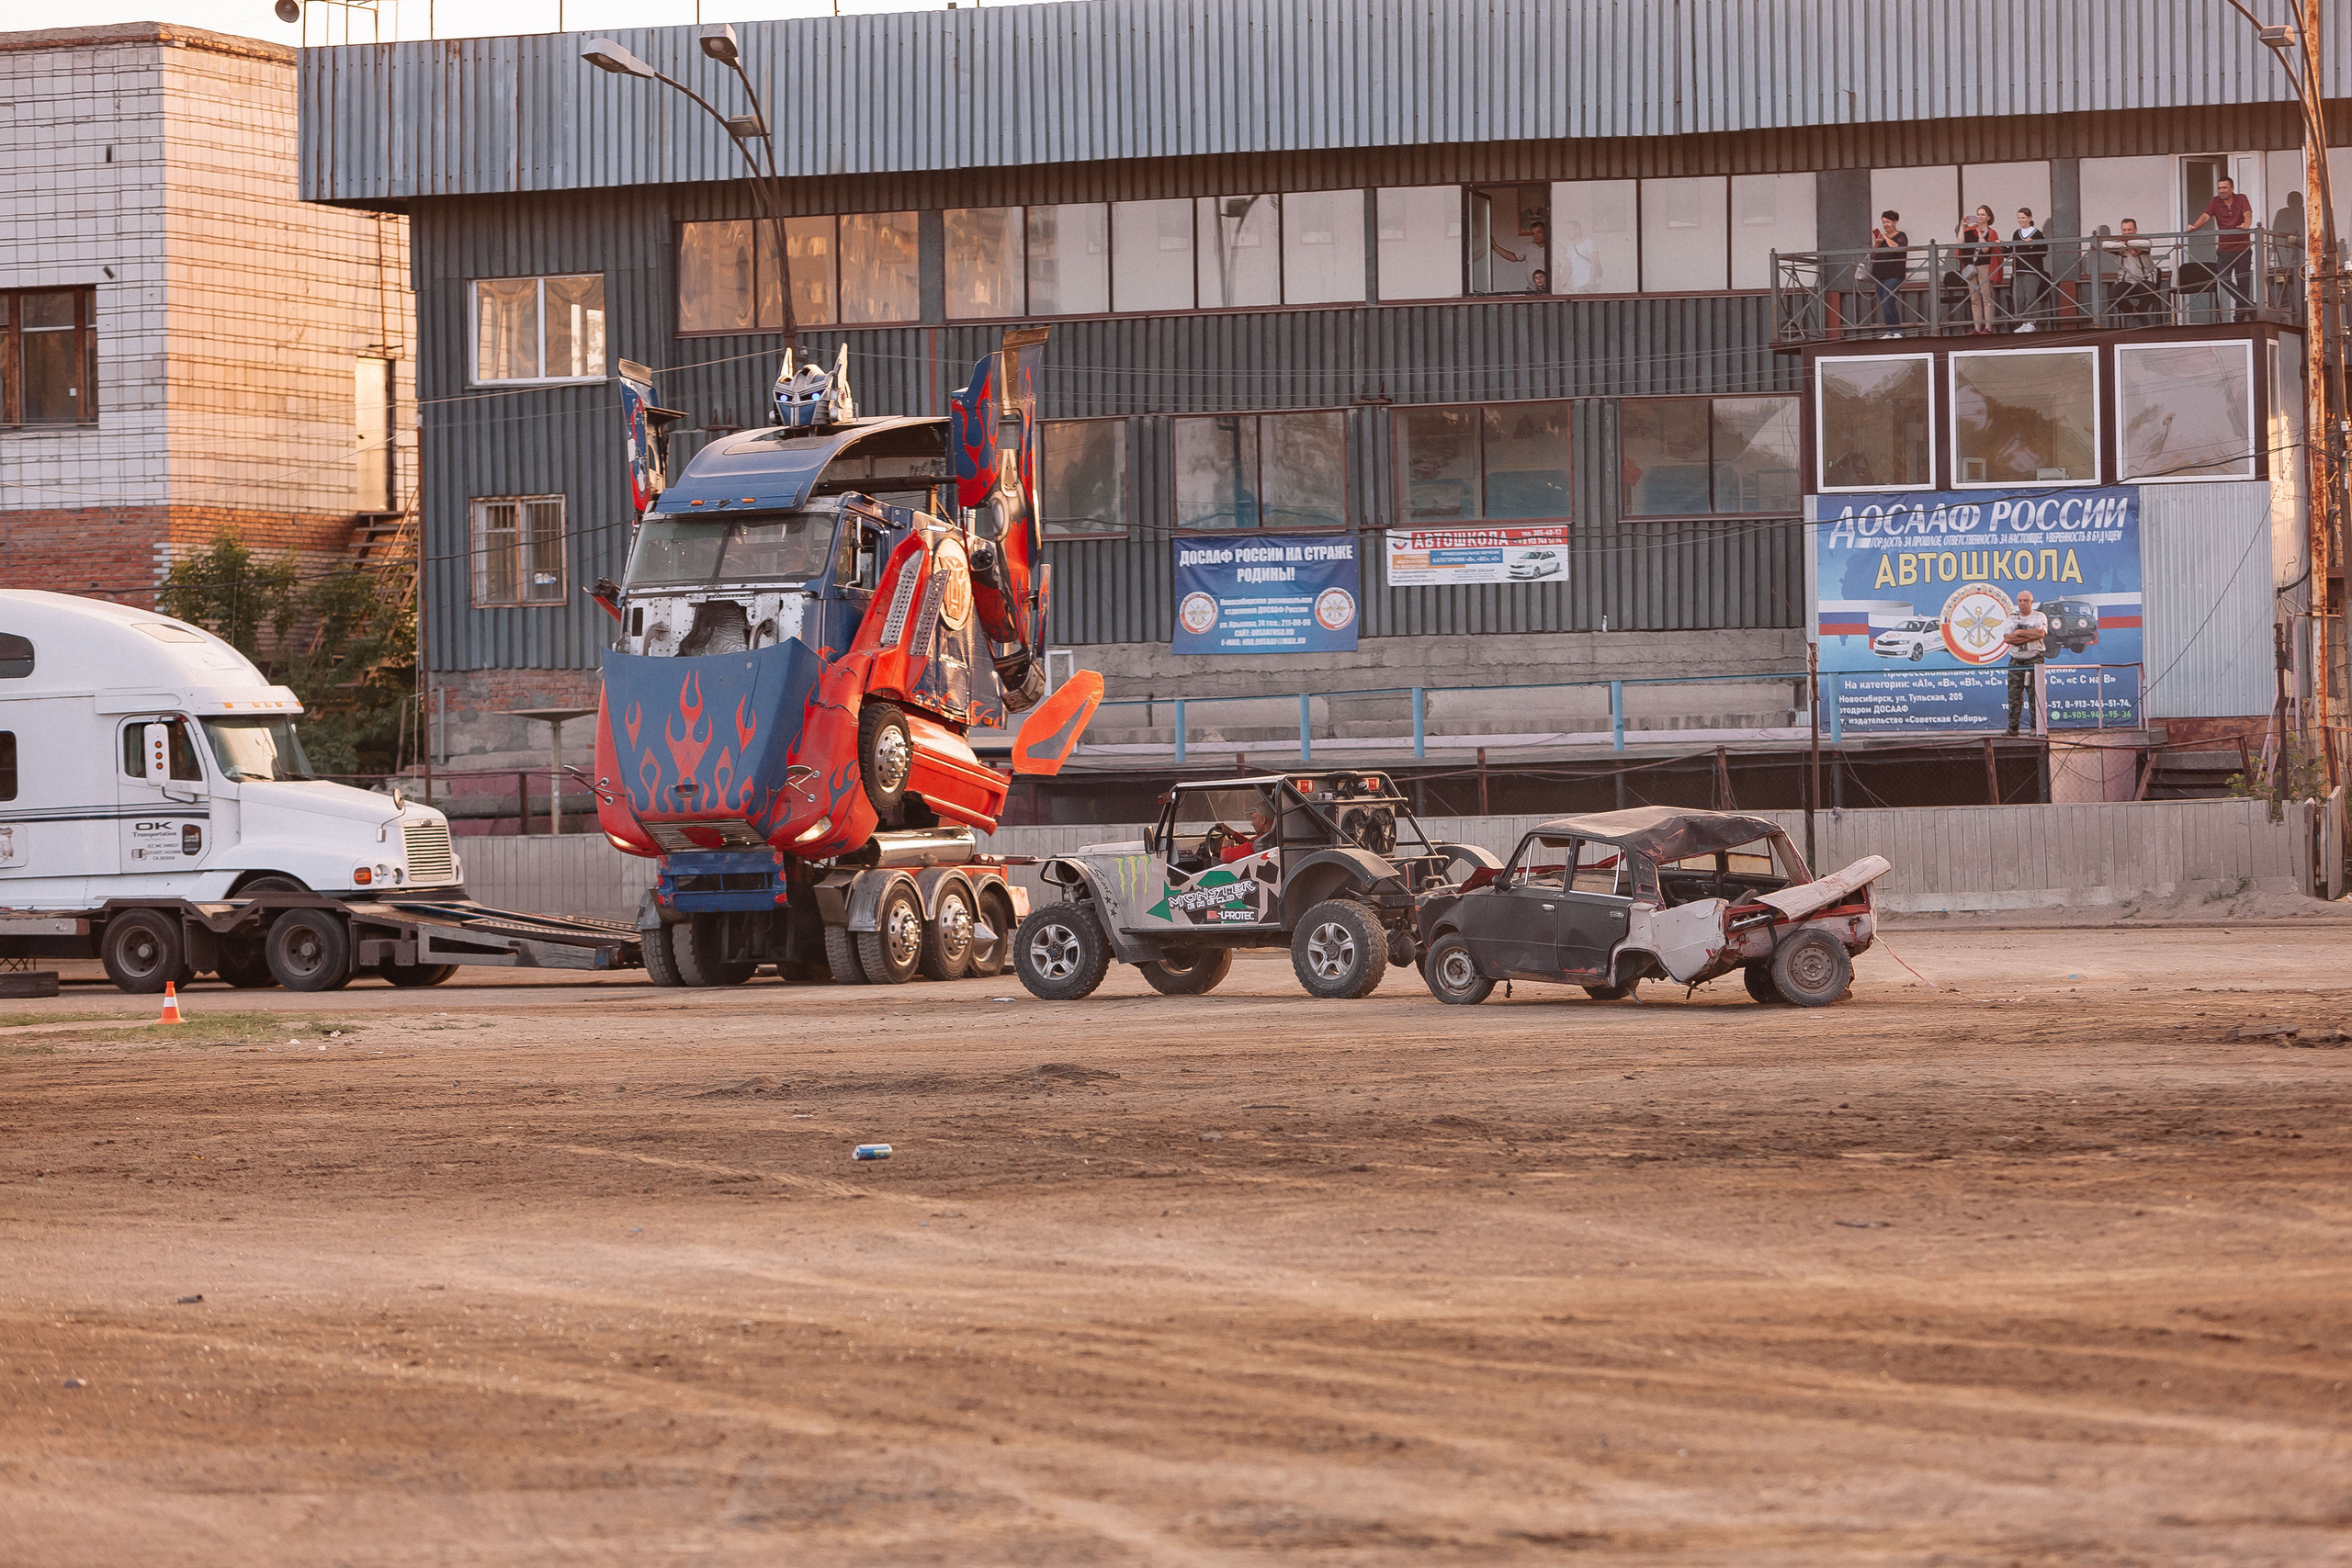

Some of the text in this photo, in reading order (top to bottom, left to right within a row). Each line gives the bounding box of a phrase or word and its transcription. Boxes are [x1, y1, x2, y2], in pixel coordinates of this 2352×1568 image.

[1828, 497, 2129, 549] ДОСААФ РОССИИ
[1414, 530, 1509, 548] АВТОШКОЛА
[1870, 536, 1903, 550] ГОРДОСТЬ
[1903, 536, 1912, 547] ЗА
[1999, 533, 2007, 544] ЗА
[1179, 545, 1353, 567] ДОСААФ РОССИИ НА СТРАЖЕ
[1237, 567, 1295, 583] РОДИНЫ!
[1873, 547, 2084, 590] АВТОШКОЛА
[1844, 680, 1857, 689] На
[1860, 680, 1910, 691] категории:
[1838, 693, 1963, 705] Новосибирск, ул. Тульская, 205
[1873, 705, 1909, 715] ДОСААФ
[1849, 716, 1903, 725] издательство
[1905, 715, 1951, 724] «Советская
[1953, 714, 1987, 724] Сибирь»
[135, 821, 173, 830] OK
[1168, 880, 1256, 909] MONSTER
[1187, 893, 1244, 910] ENERGY
